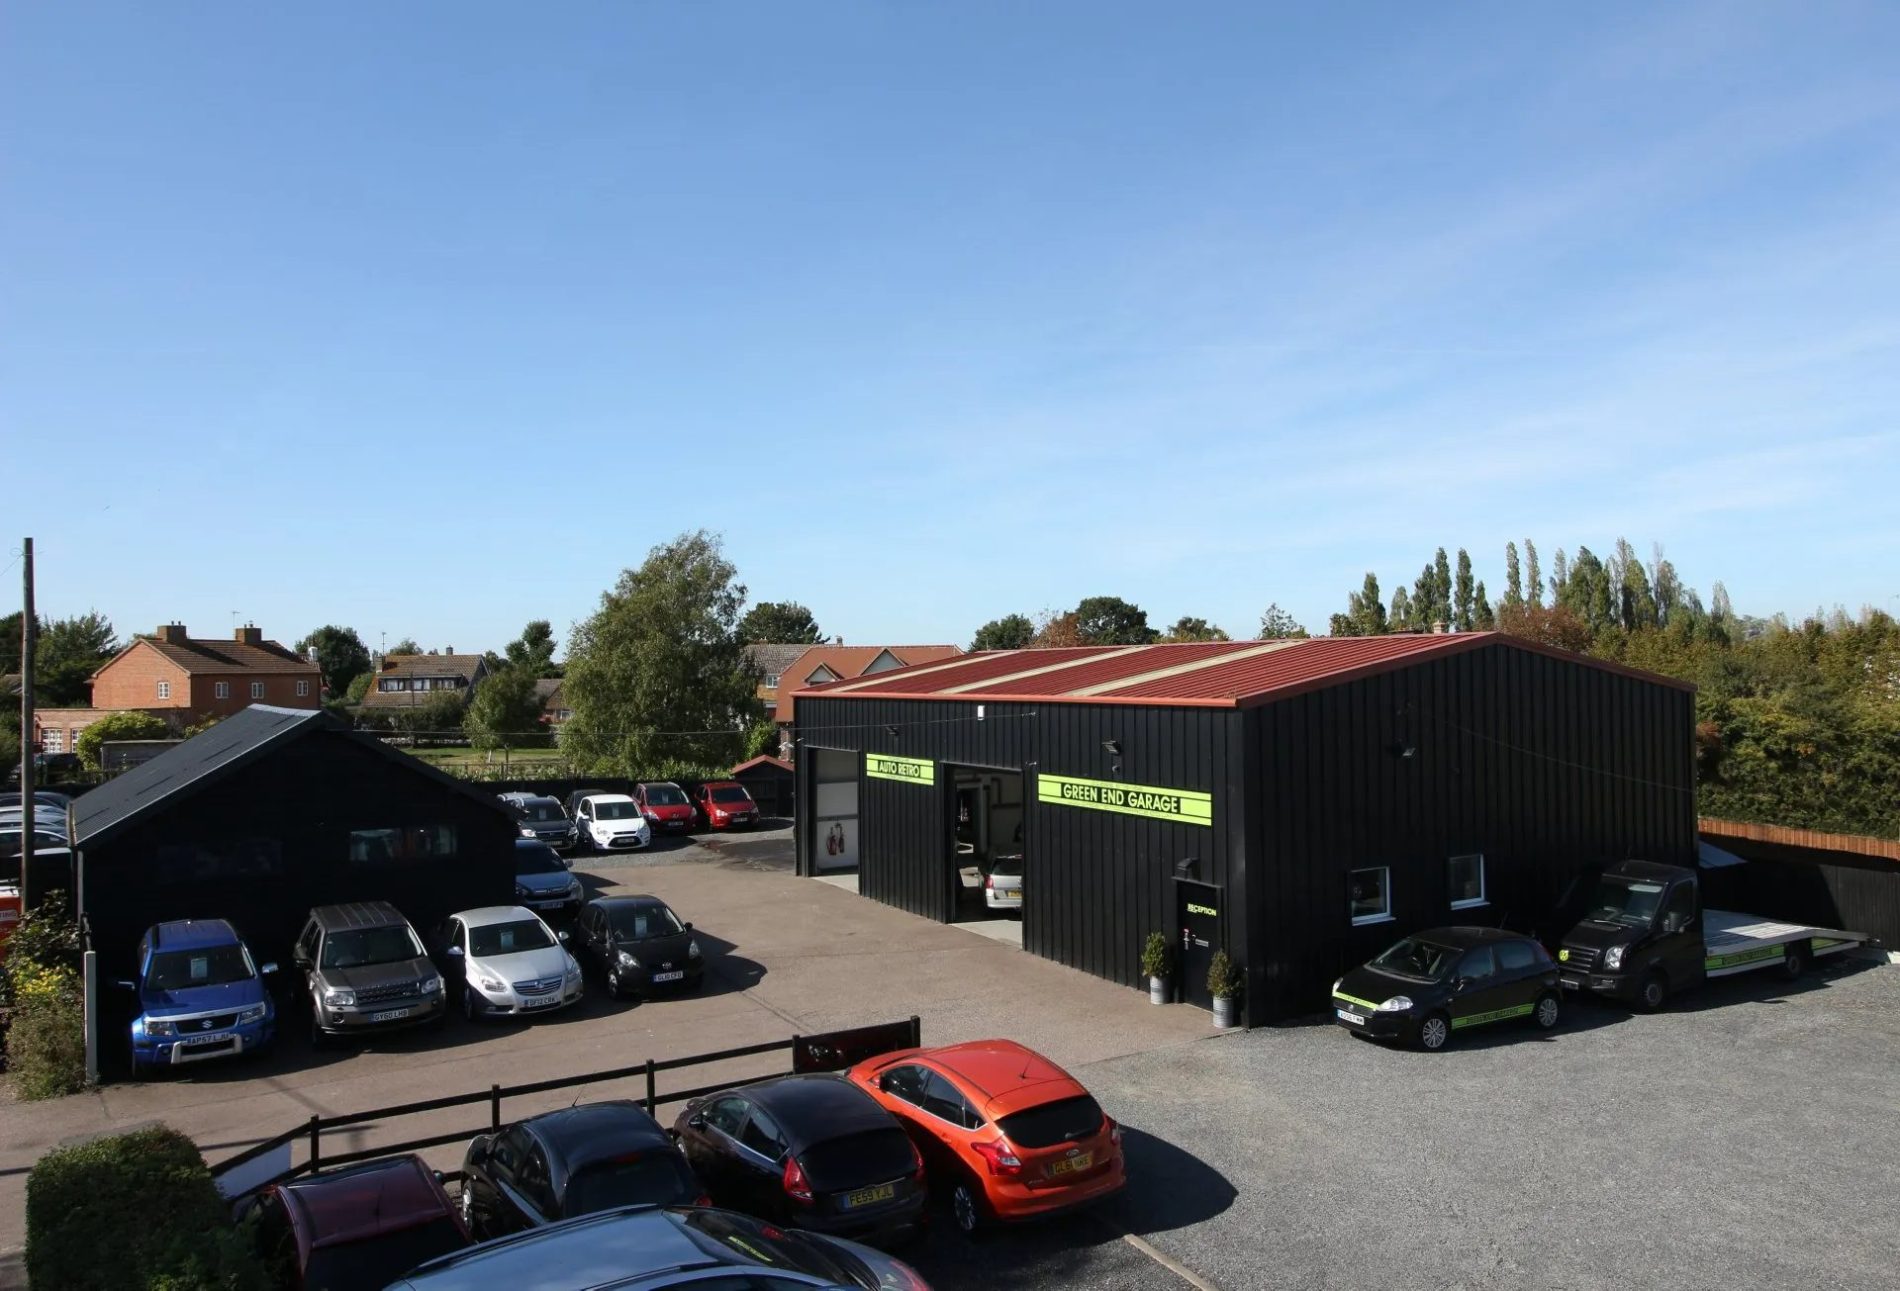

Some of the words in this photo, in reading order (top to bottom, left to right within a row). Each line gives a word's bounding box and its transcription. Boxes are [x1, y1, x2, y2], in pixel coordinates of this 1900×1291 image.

[879, 761, 897, 774] AUTO
[898, 763, 920, 777] RETRO
[1063, 784, 1098, 802] GREEN
[1101, 789, 1124, 805] END
[1127, 792, 1178, 813] GARAGE
[1187, 903, 1217, 916] RECEPTION
[849, 1191, 873, 1205] FE59
